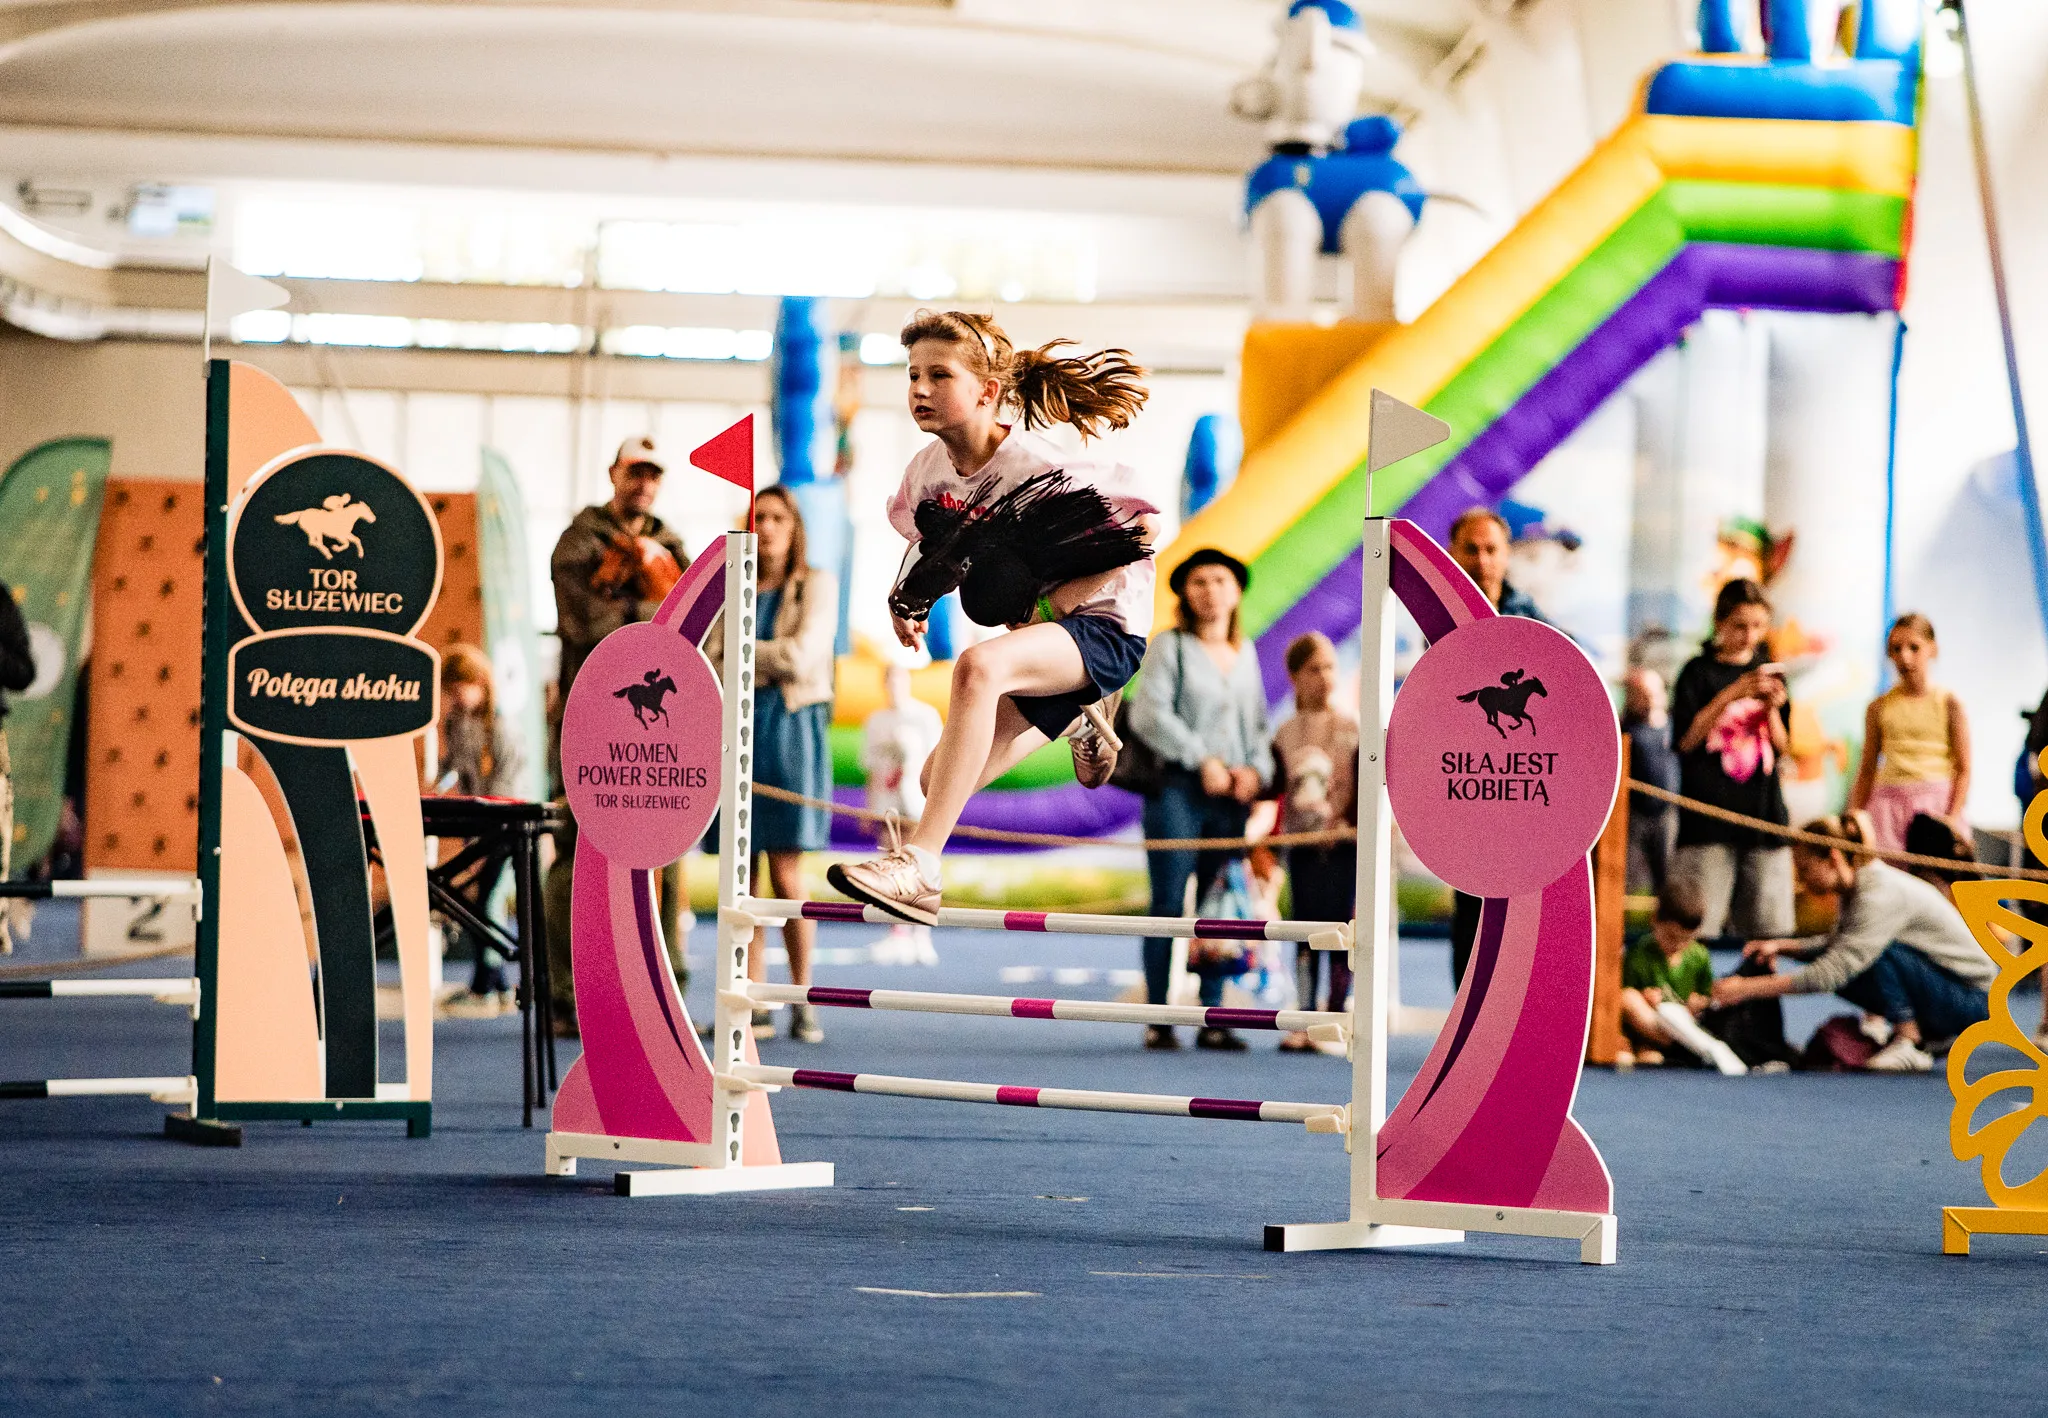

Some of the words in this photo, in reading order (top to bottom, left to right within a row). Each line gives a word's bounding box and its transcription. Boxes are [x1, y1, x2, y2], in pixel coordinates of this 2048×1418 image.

[309, 568, 358, 590] TOR
[247, 667, 338, 706] Potęga
[341, 672, 420, 701] skoku
[608, 742, 678, 763] WOMEN
[1441, 751, 1495, 774] SIŁA
[1498, 752, 1559, 775] JEST
[578, 765, 641, 785] POWER
[646, 766, 707, 787] SERIES
[594, 794, 618, 808] TOR
[1447, 778, 1550, 806] KOBIETĄ
[127, 893, 163, 941] 2
